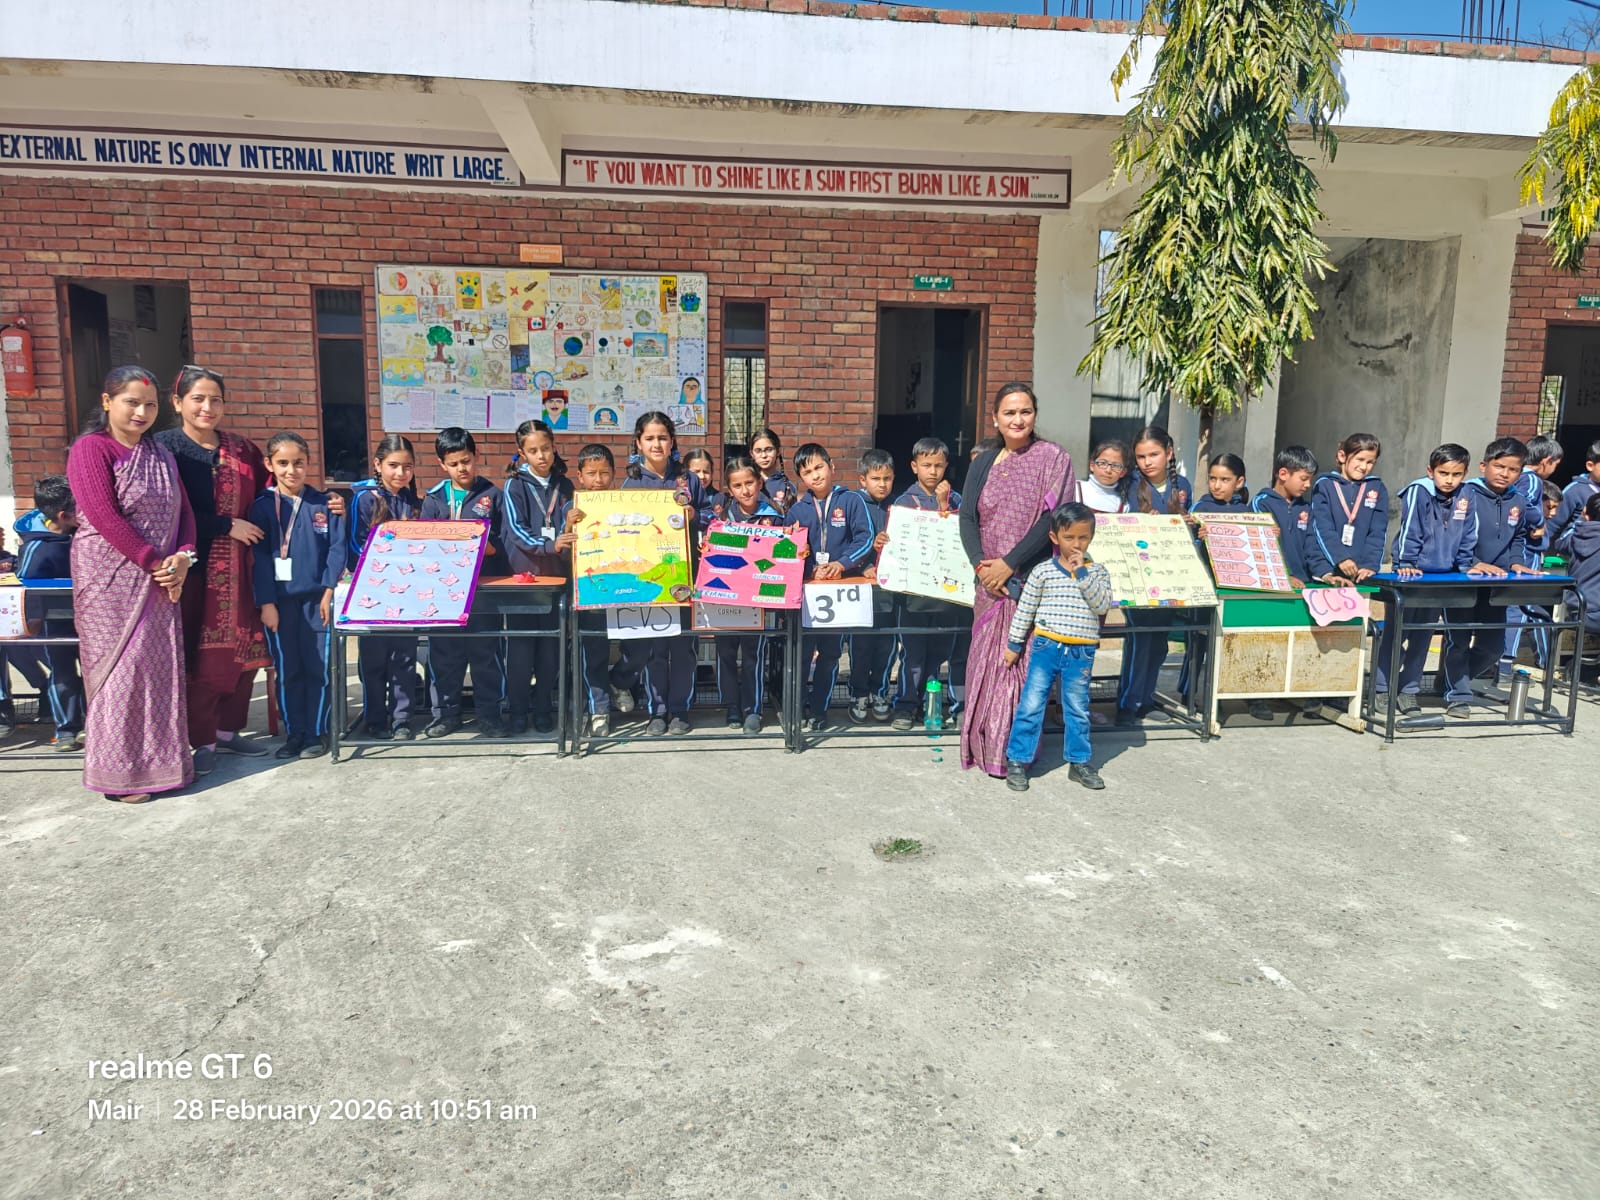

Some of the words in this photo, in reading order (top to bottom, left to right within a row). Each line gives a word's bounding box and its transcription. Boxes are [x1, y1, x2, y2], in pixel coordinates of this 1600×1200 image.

[0, 134, 87, 161] EXTERNAL
[95, 138, 162, 164] NATURE
[168, 141, 186, 165] IS
[189, 143, 232, 167] ONLY
[240, 145, 327, 172] INTERNAL
[332, 150, 396, 175] NATURE
[405, 153, 445, 178] WRIT
[453, 155, 510, 181] LARGE.
[604, 160, 636, 185] YOU
[640, 162, 687, 187] WANT
[692, 164, 712, 188] TO
[716, 166, 764, 190] SHINE
[767, 167, 801, 191] LIKE
[804, 169, 814, 191] A
[816, 169, 846, 192] SUN
[849, 170, 893, 194] FIRST
[898, 172, 943, 195] BURN
[948, 174, 981, 197] LIKE
[986, 175, 997, 197] A
[584, 491, 625, 503] WATER
[630, 491, 674, 504] CYCLE
[727, 526, 778, 537] SHAPES
[815, 585, 860, 623] 3rd
[1309, 588, 1357, 616] CCS
